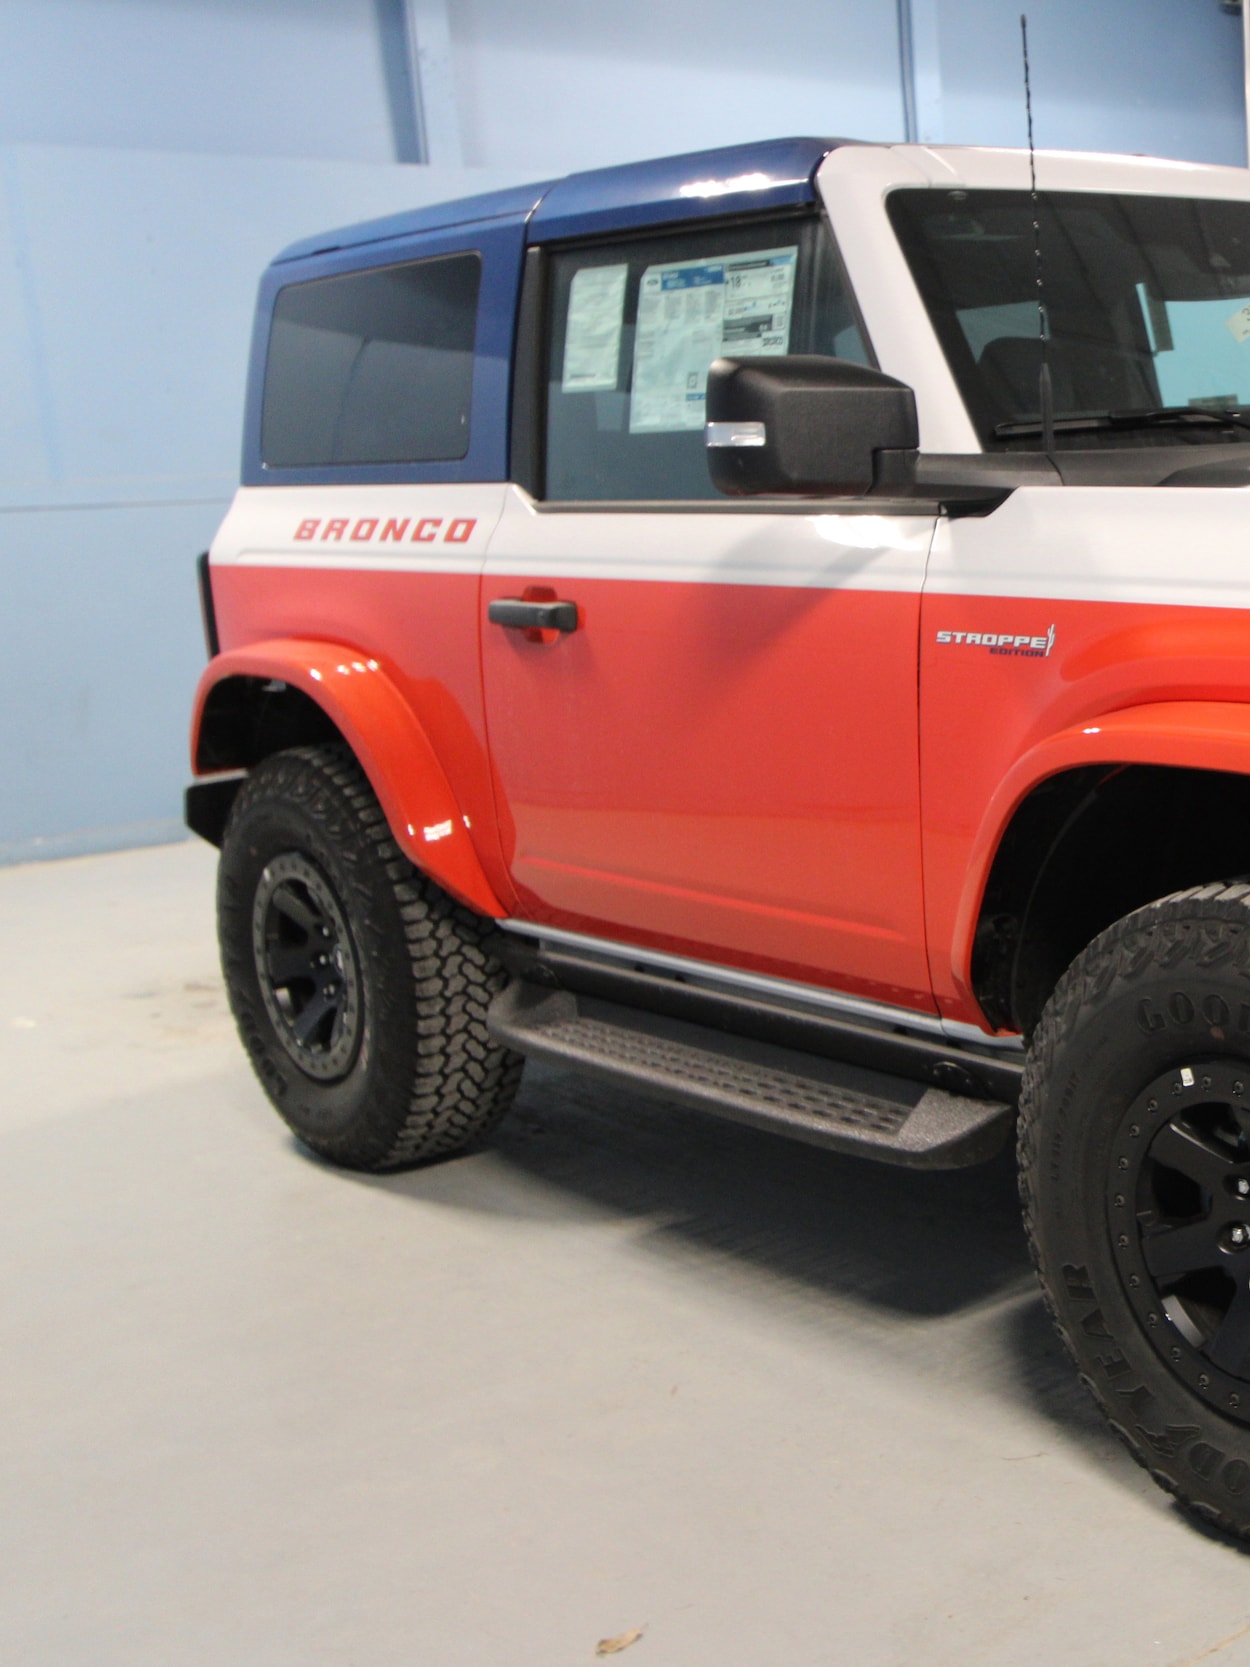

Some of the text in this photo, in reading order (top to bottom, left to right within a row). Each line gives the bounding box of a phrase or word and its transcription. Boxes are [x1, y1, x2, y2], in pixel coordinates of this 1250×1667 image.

[293, 517, 477, 544] BRONCO
[936, 630, 1047, 649] STROPPE
[989, 647, 1045, 658] EDITION
